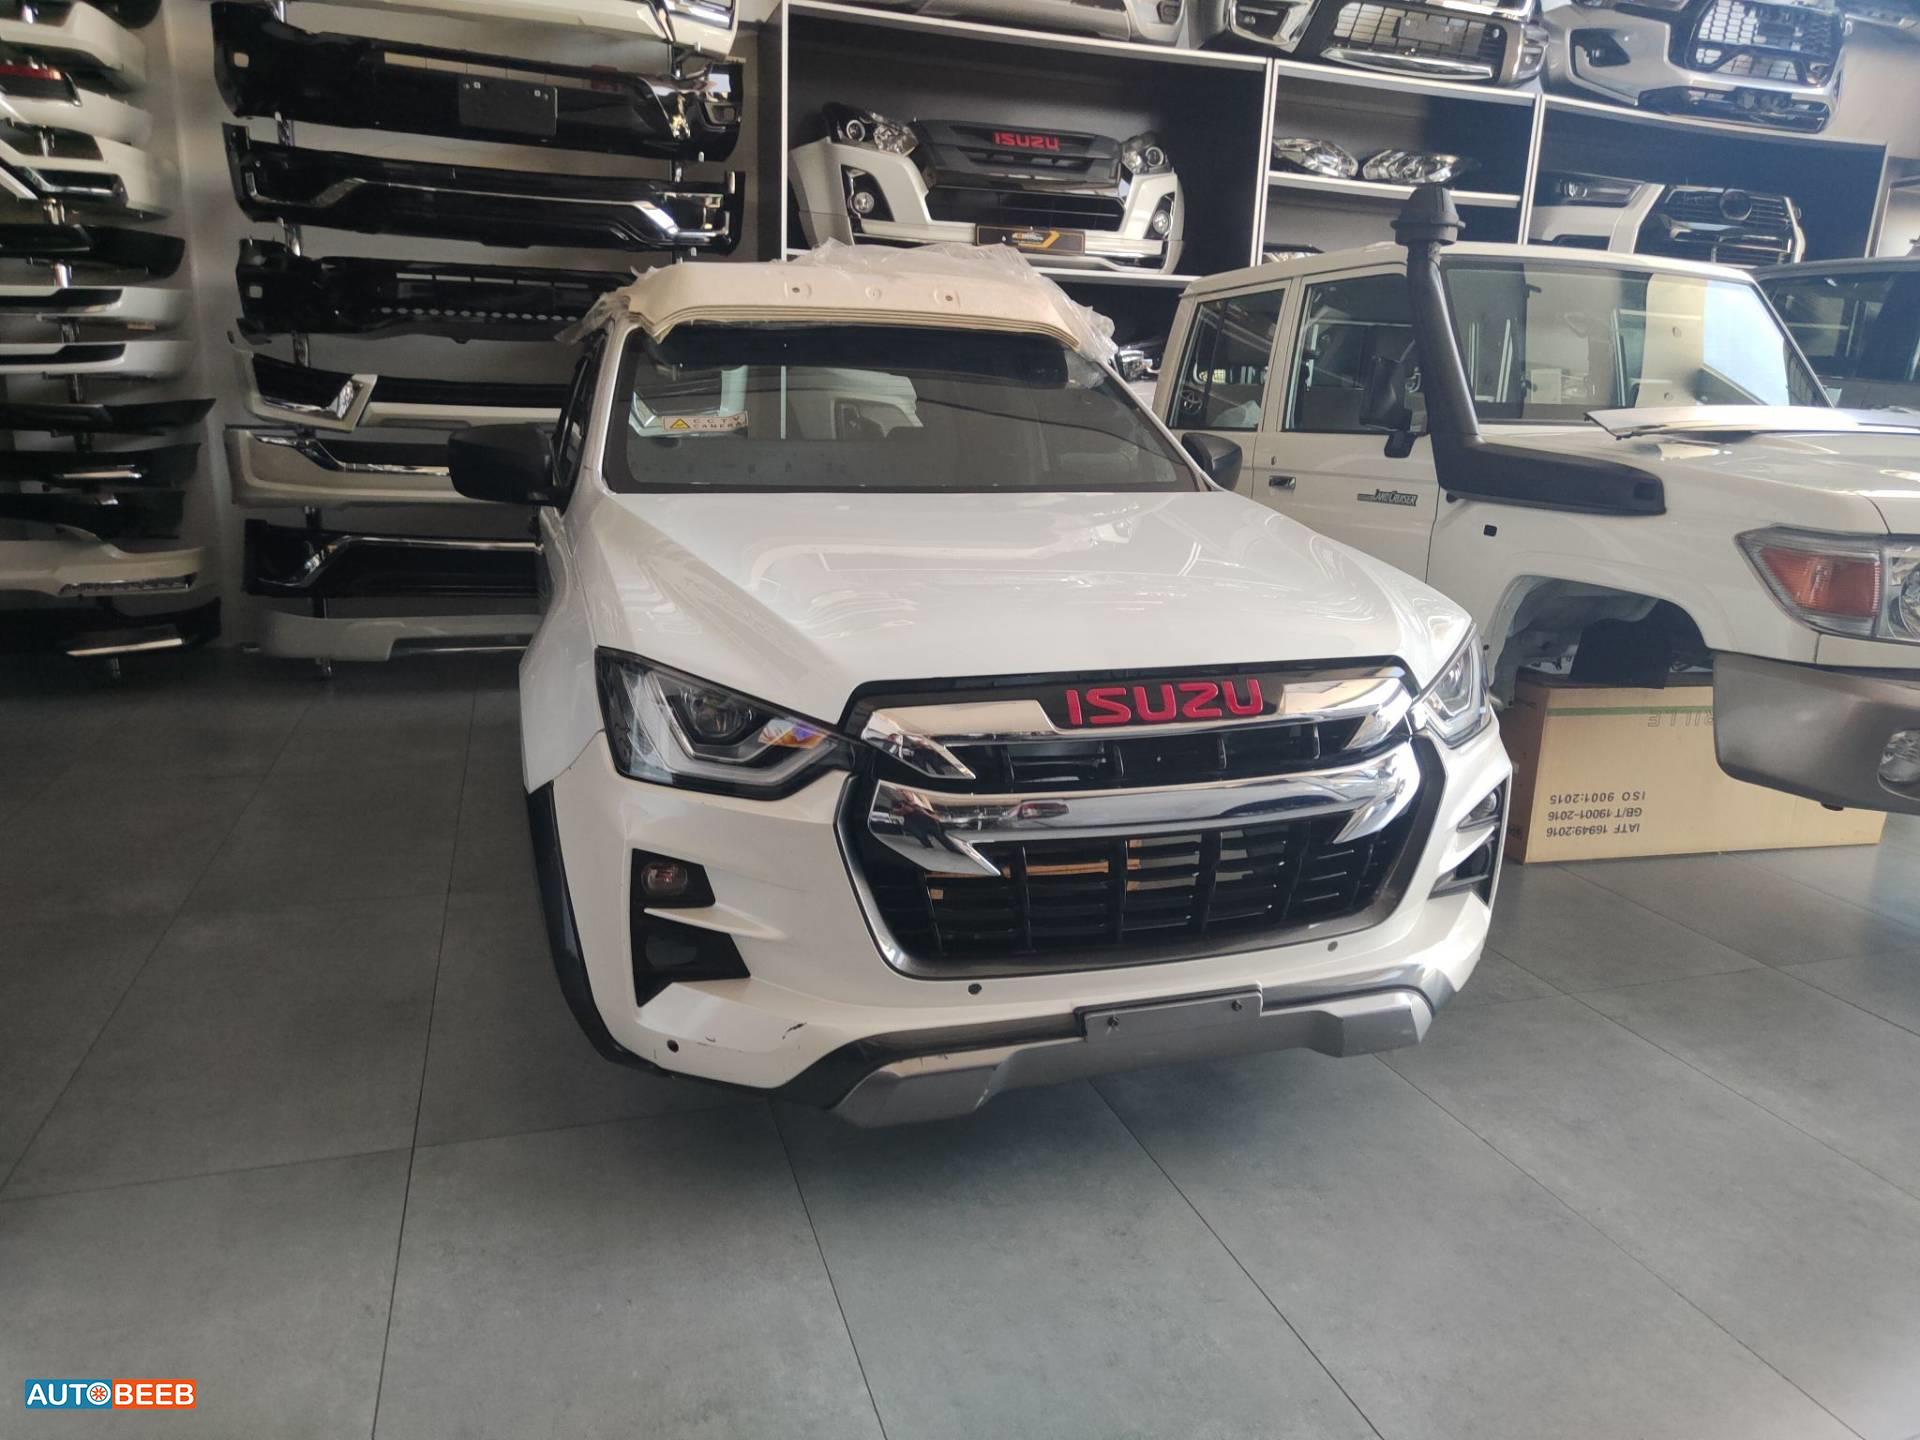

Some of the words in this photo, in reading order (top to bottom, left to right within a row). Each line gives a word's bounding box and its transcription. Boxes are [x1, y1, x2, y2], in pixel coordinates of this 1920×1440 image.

[993, 131, 1059, 151] ISUZU
[1066, 679, 1263, 726] ISUZU
[1550, 792, 1615, 805] 9001:2015
[1621, 791, 1645, 802] ISO
[1548, 808, 1611, 821] 19001-2016
[1614, 807, 1642, 818] GB/T
[1546, 824, 1607, 838] 16949:2016
[1613, 823, 1640, 834] IATF
